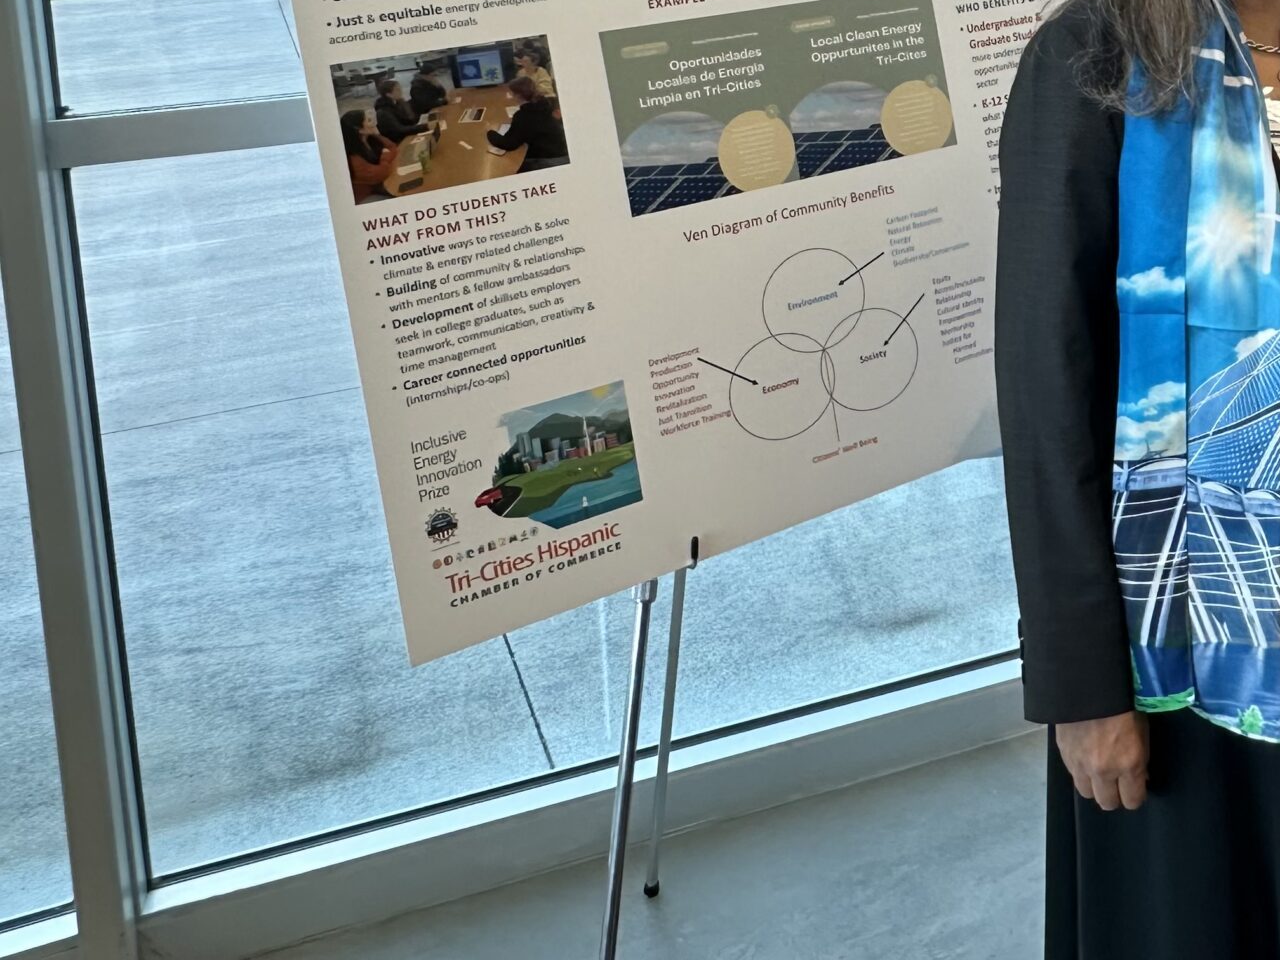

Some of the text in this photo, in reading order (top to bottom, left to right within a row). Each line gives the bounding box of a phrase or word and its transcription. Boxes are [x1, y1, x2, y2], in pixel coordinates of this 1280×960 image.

[335, 14, 364, 29] Just
[366, 13, 376, 24] &
[378, 3, 443, 23] equitable
[444, 2, 480, 14] energy
[954, 1, 980, 14] WHO
[328, 16, 479, 45] according to Justice40 Goals
[809, 21, 922, 48] Local Clean Energy
[891, 38, 904, 49] in
[904, 35, 925, 47] the
[668, 47, 762, 72] Oportunidades
[638, 78, 762, 108] Limpia en Tri-Cities
[647, 73, 697, 91] Locales
[699, 70, 716, 82] de
[361, 181, 557, 232] WHAT DO STUDENTS TAKE
[682, 184, 895, 243] Ven Diagram of Community Benefits
[365, 210, 506, 251] AWAY FROM THIS?
[409, 429, 467, 455] Inclusive
[412, 448, 458, 471] Energy
[415, 458, 483, 487] Innovation
[417, 484, 450, 503] Prize
[443, 522, 622, 594] Tri-Cities Hispanic
[449, 540, 622, 608] CHAMBER OF COMMERCE
